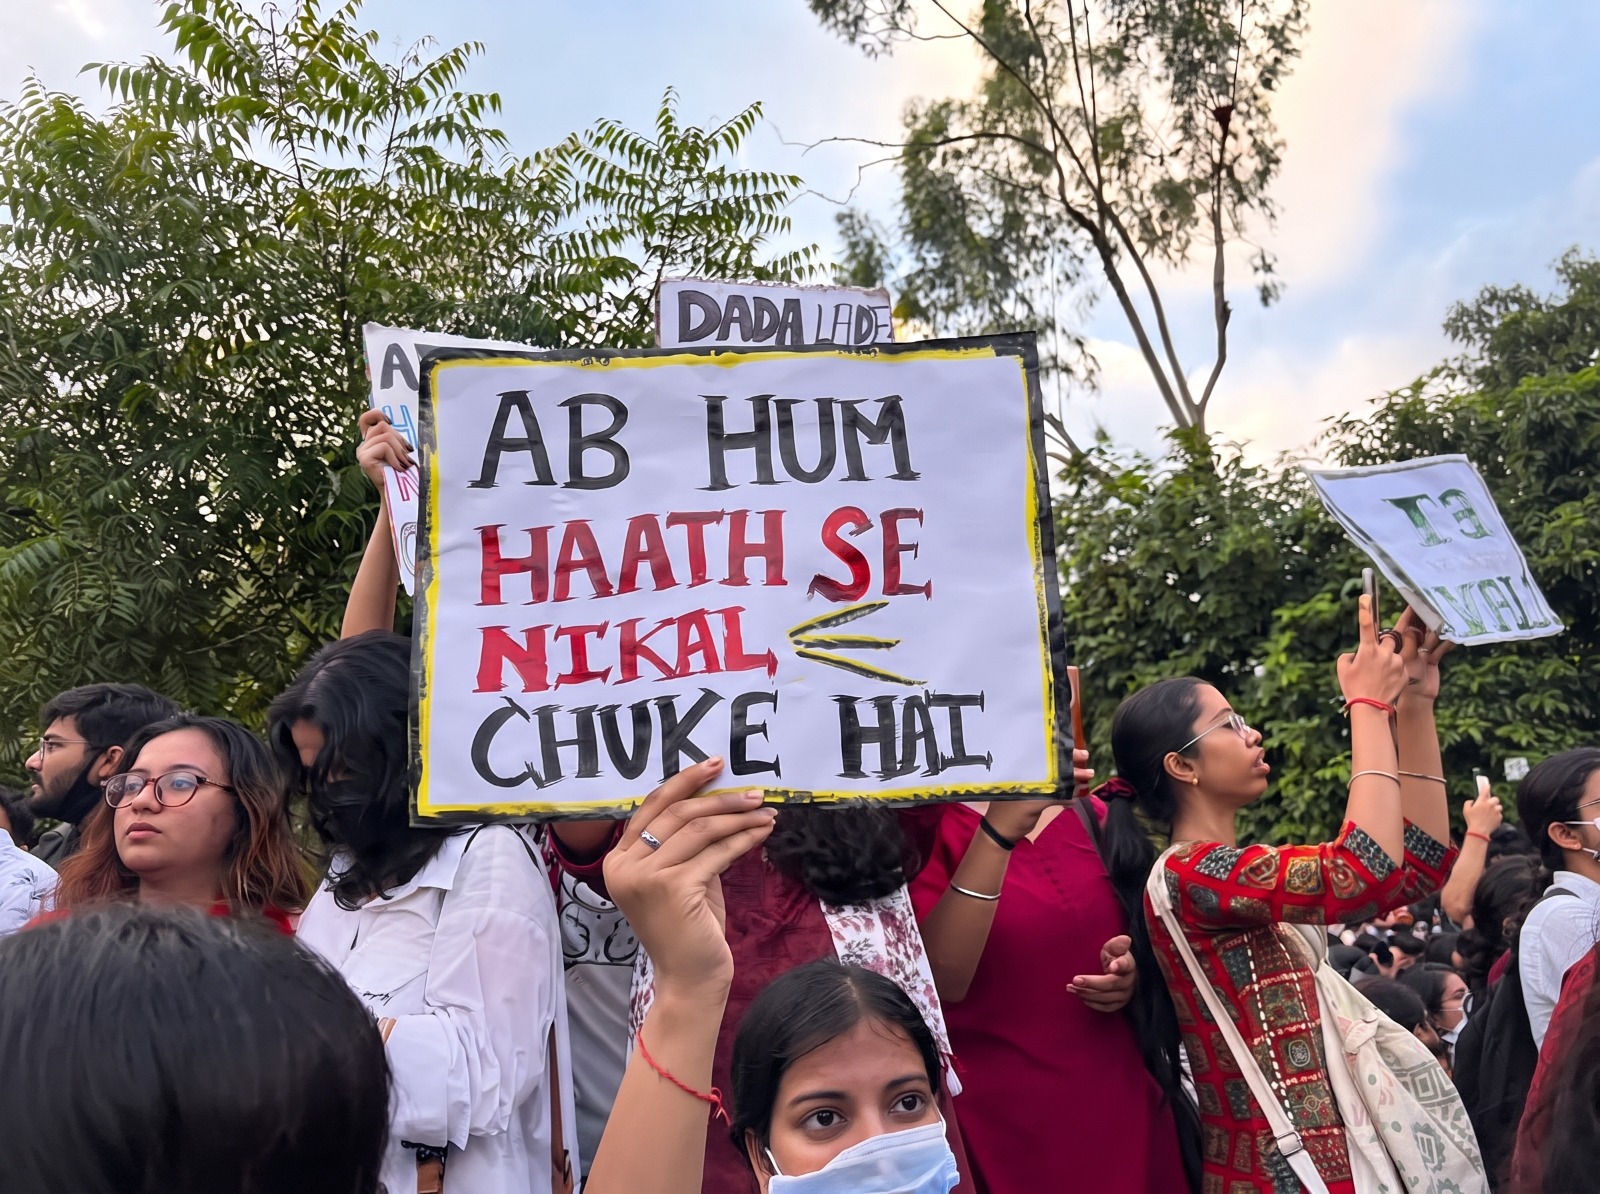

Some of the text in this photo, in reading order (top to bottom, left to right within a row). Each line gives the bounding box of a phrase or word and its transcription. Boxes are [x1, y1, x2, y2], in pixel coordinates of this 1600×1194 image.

[678, 290, 804, 345] DADA
[466, 390, 630, 490] AB
[697, 394, 922, 491] HUM
[473, 508, 788, 606] HAATH
[807, 505, 932, 602] SE
[472, 605, 779, 693] NIKAL
[471, 687, 993, 790] CHUKE HAI
